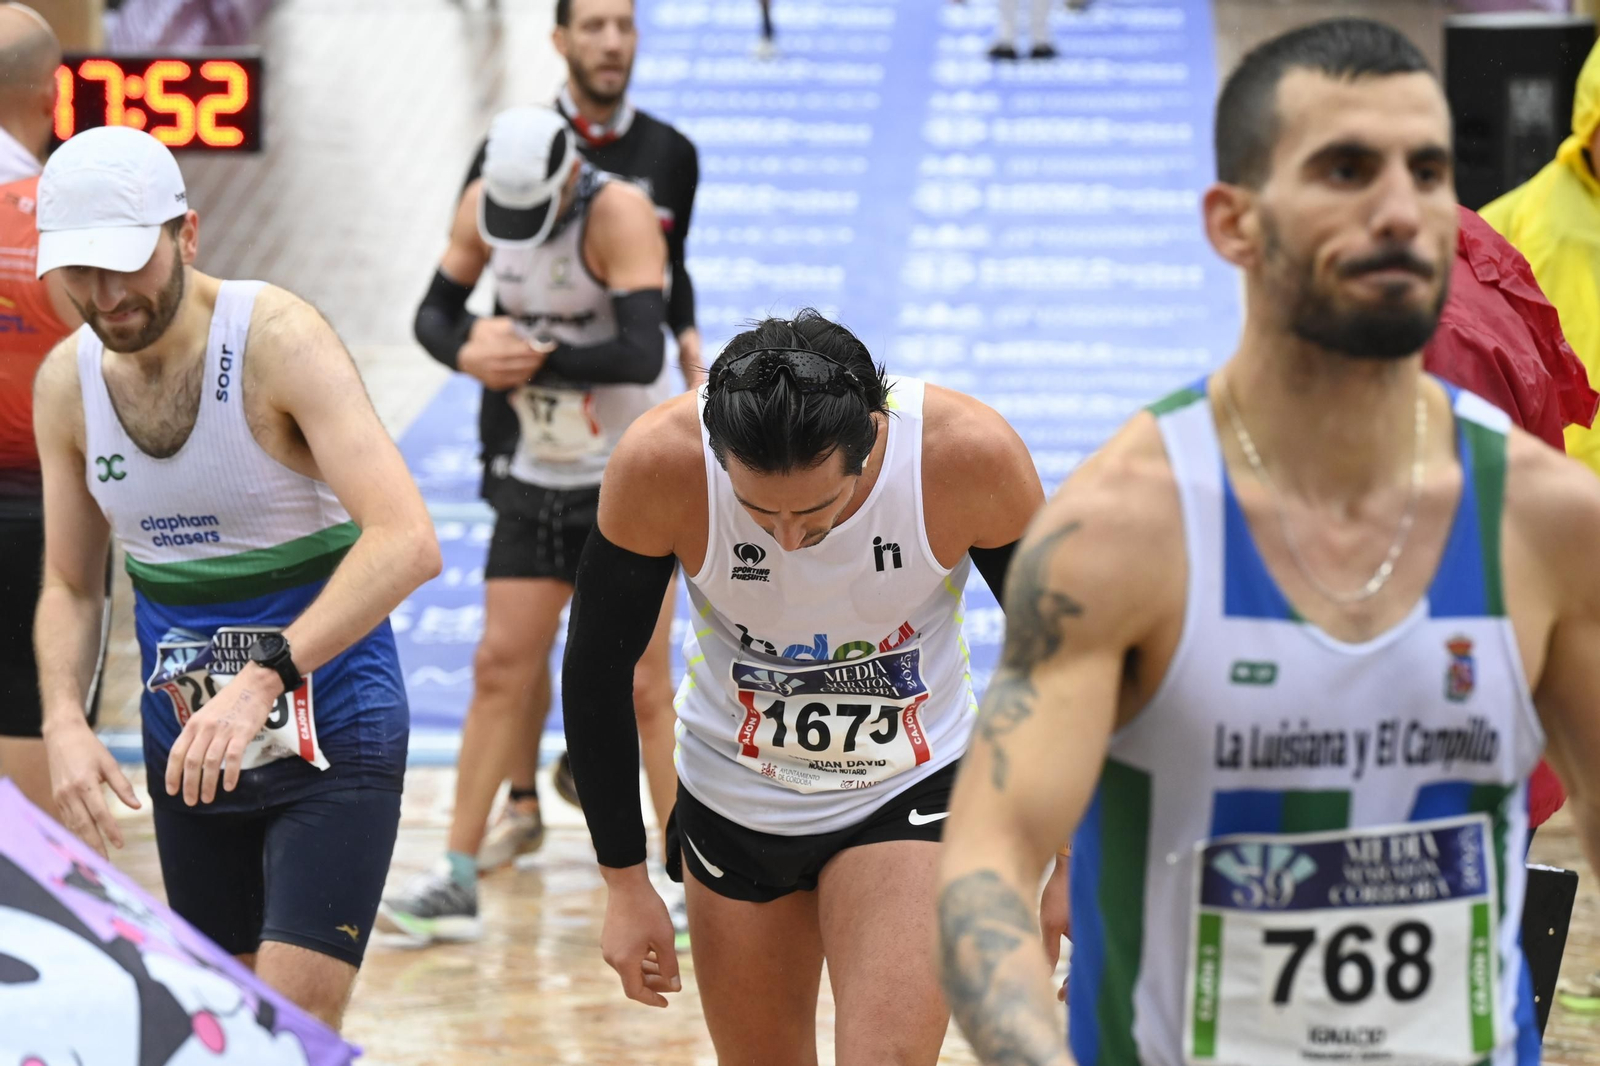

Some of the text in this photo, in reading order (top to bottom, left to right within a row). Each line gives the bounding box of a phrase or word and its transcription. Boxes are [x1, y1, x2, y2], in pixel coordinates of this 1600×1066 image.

[54, 60, 248, 146] 17:52
[216, 344, 234, 402] soar
[140, 513, 219, 532] clapham
[152, 529, 220, 547] chasers
[872, 536, 903, 571] in
[731, 566, 771, 576] SPORTING
[824, 660, 887, 682] MEDIA
[900, 653, 918, 690] 2025
[742, 717, 757, 745] AJÓN
[1215, 714, 1499, 780] La Luisiana y El Campillo
[779, 767, 821, 780] AYUNTAMIENTO
[840, 768, 867, 776] NOTARIO
[847, 759, 886, 768] DAVID
[778, 774, 785, 782] DE
[1262, 919, 1434, 1007] 768
